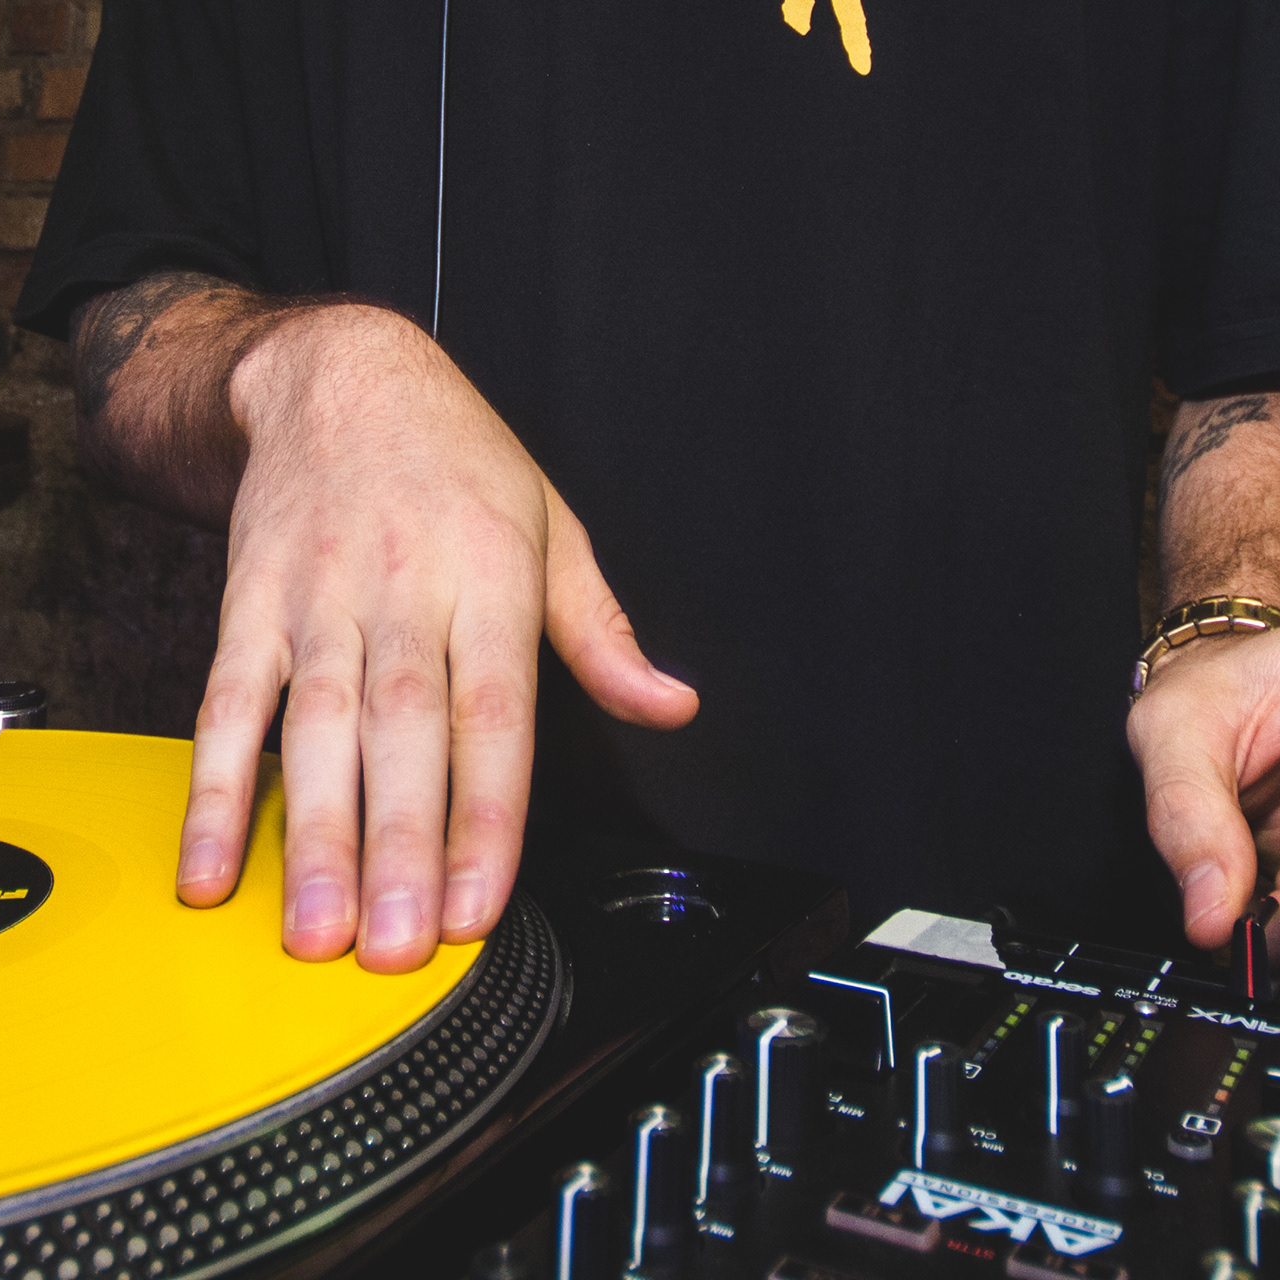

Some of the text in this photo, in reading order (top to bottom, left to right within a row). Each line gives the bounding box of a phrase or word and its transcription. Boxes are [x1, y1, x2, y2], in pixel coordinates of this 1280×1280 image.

[1003, 970, 1102, 997] serato
[878, 1180, 1119, 1257] AKAI
[907, 1174, 1117, 1237] PROFESSIONAL
